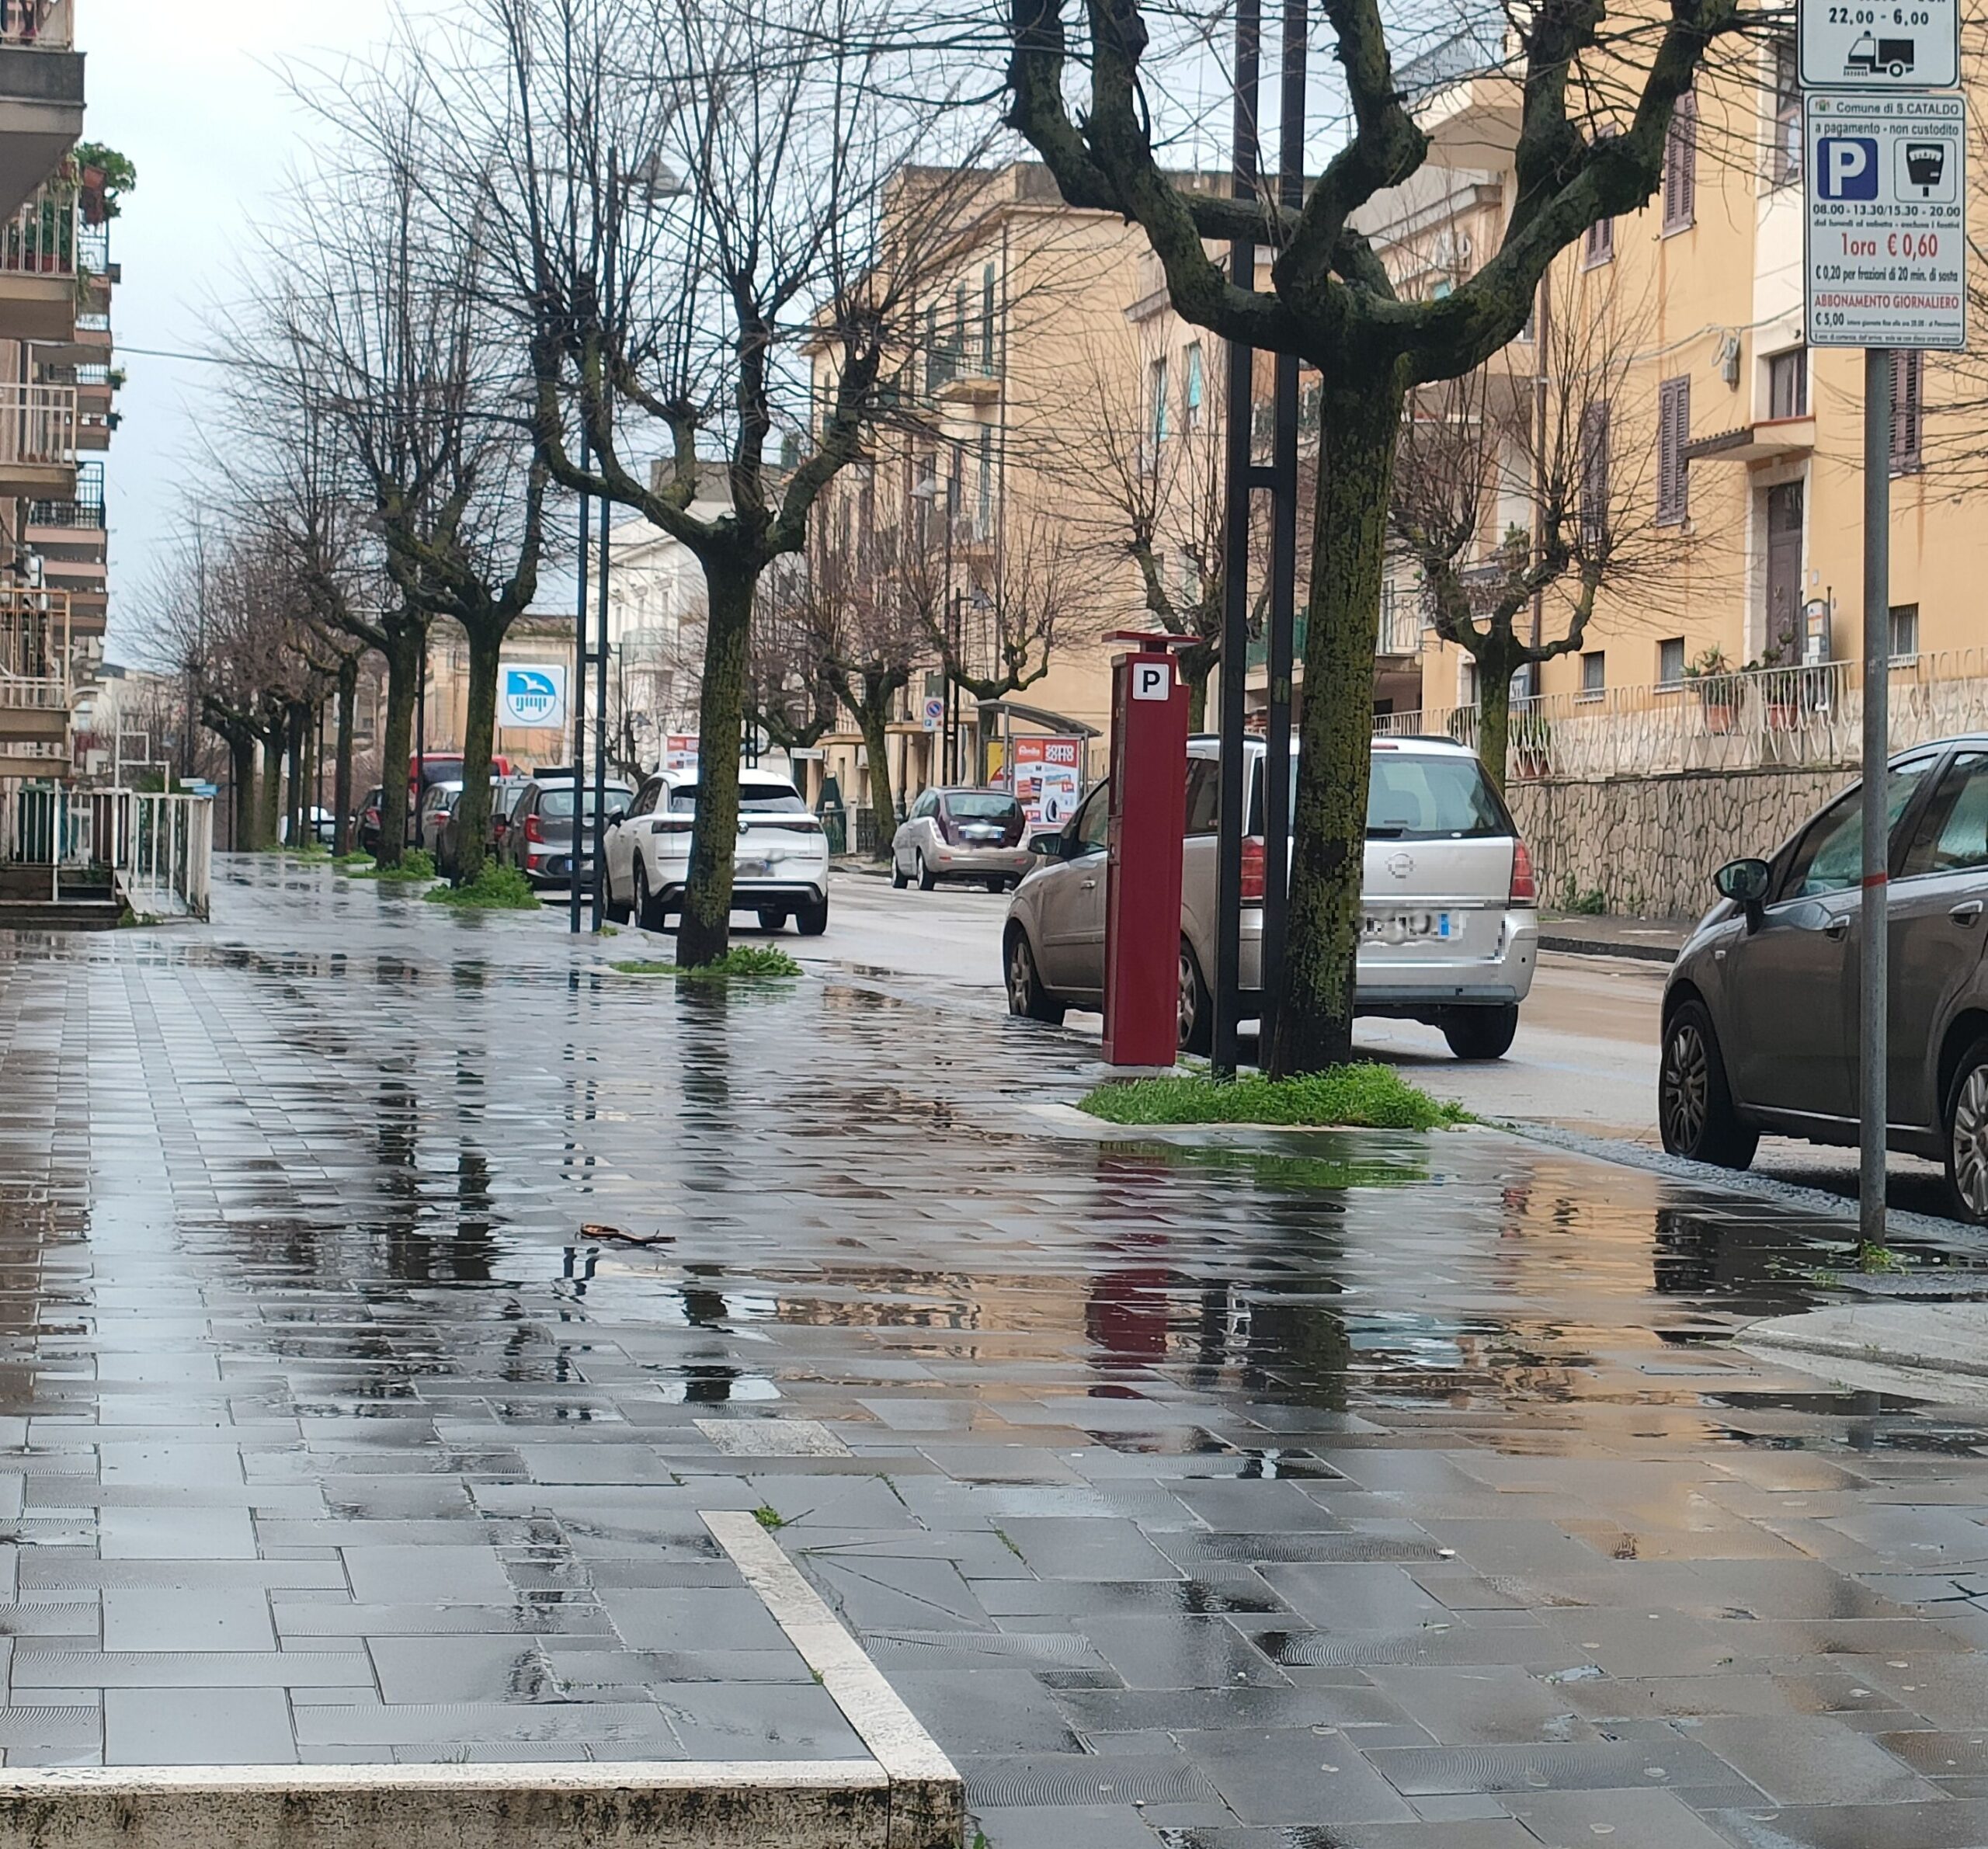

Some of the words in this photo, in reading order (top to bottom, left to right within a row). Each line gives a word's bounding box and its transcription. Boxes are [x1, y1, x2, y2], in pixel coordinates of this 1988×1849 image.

[1837, 102, 1880, 113] Comune
[1883, 103, 1893, 113] di
[1816, 123, 1821, 134] a
[1824, 122, 1880, 137] pagamento
[1889, 125, 1909, 134] non
[1912, 123, 1958, 136] custodito
[1829, 141, 1866, 196] P
[1813, 203, 1844, 215] 08.00
[1930, 206, 1961, 217] 20.00
[1888, 233, 1897, 257] €
[1903, 233, 1938, 262] 0,60
[1816, 265, 1821, 280] €
[1823, 265, 1841, 282] 0,20
[1843, 270, 1855, 283] per
[1858, 266, 1886, 280] frazioni
[1889, 266, 1896, 281] di
[1898, 266, 1908, 281] 20
[1929, 267, 1936, 282] di
[1938, 270, 1958, 283] sosta
[1814, 294, 1890, 308] ABBONAMENTO
[1893, 296, 1959, 310] GIORNALIERO
[1816, 312, 1821, 325] €
[1824, 312, 1844, 328] 5,00
[1143, 669, 1160, 693] P
